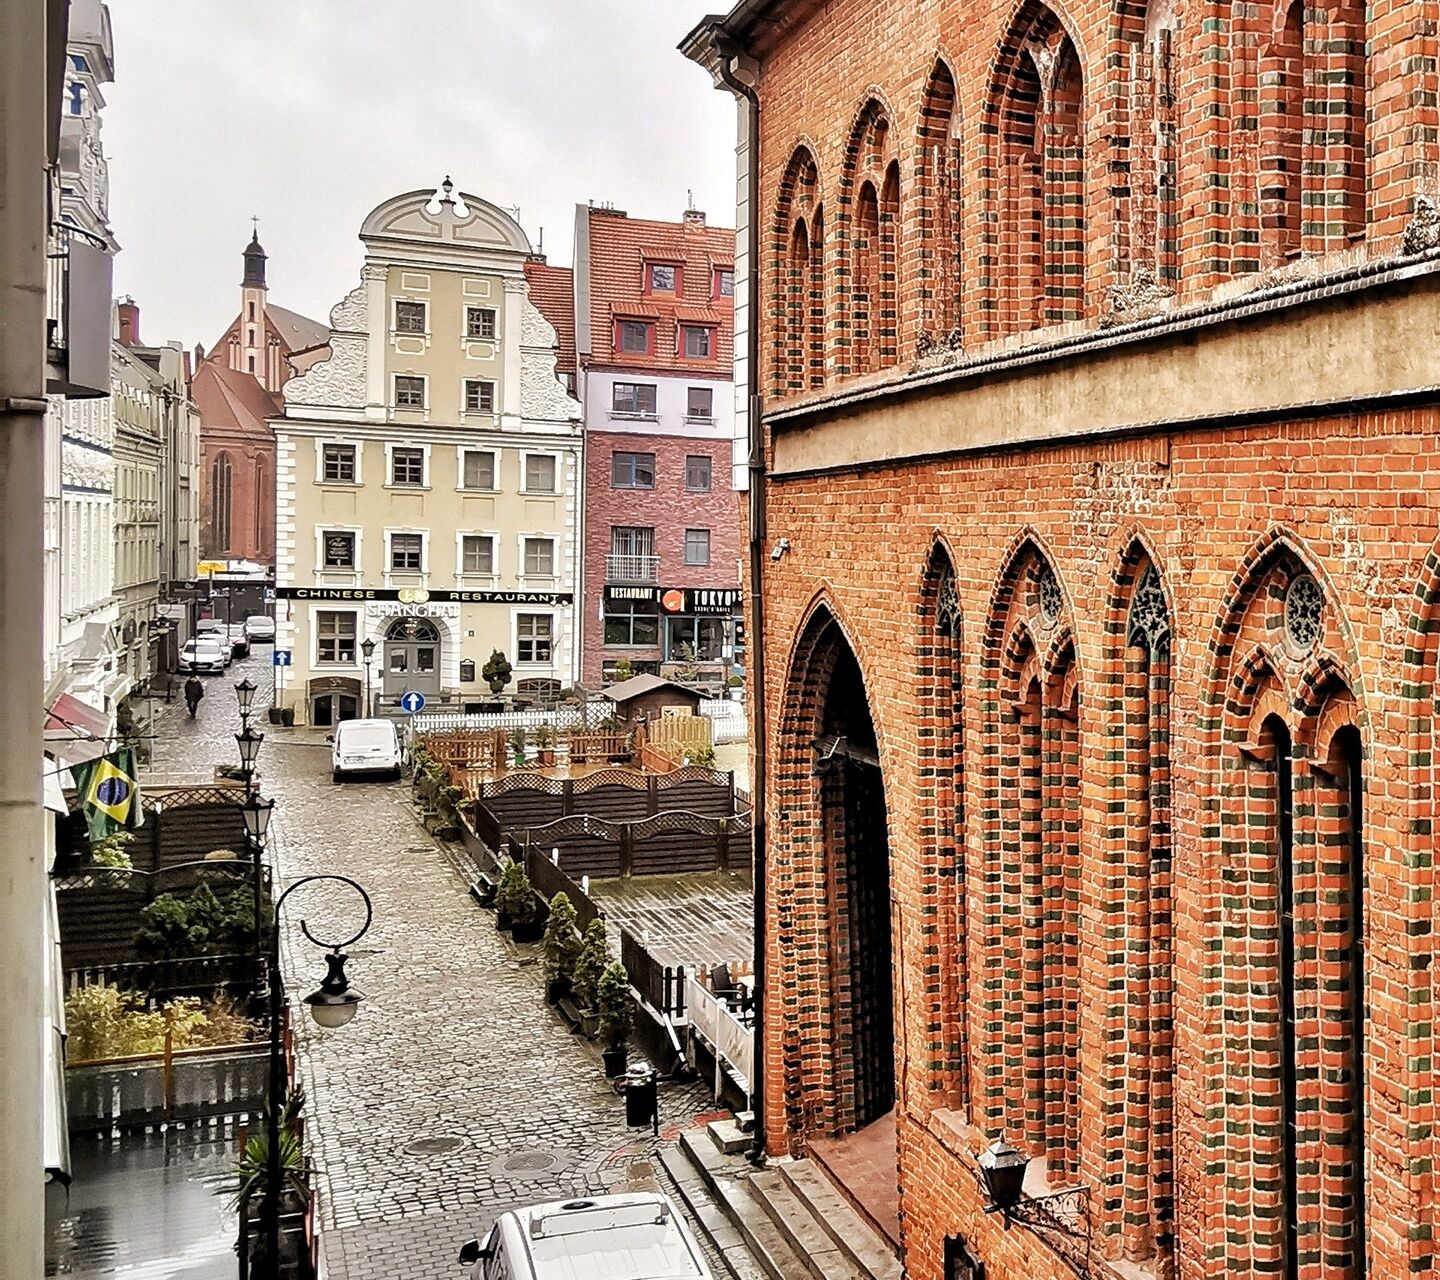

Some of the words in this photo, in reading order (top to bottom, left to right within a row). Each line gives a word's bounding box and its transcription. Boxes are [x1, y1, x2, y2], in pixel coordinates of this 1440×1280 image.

[296, 589, 375, 599] CHINESE
[449, 592, 559, 603] RESTAURANT
[611, 587, 653, 599] RESTAURANT
